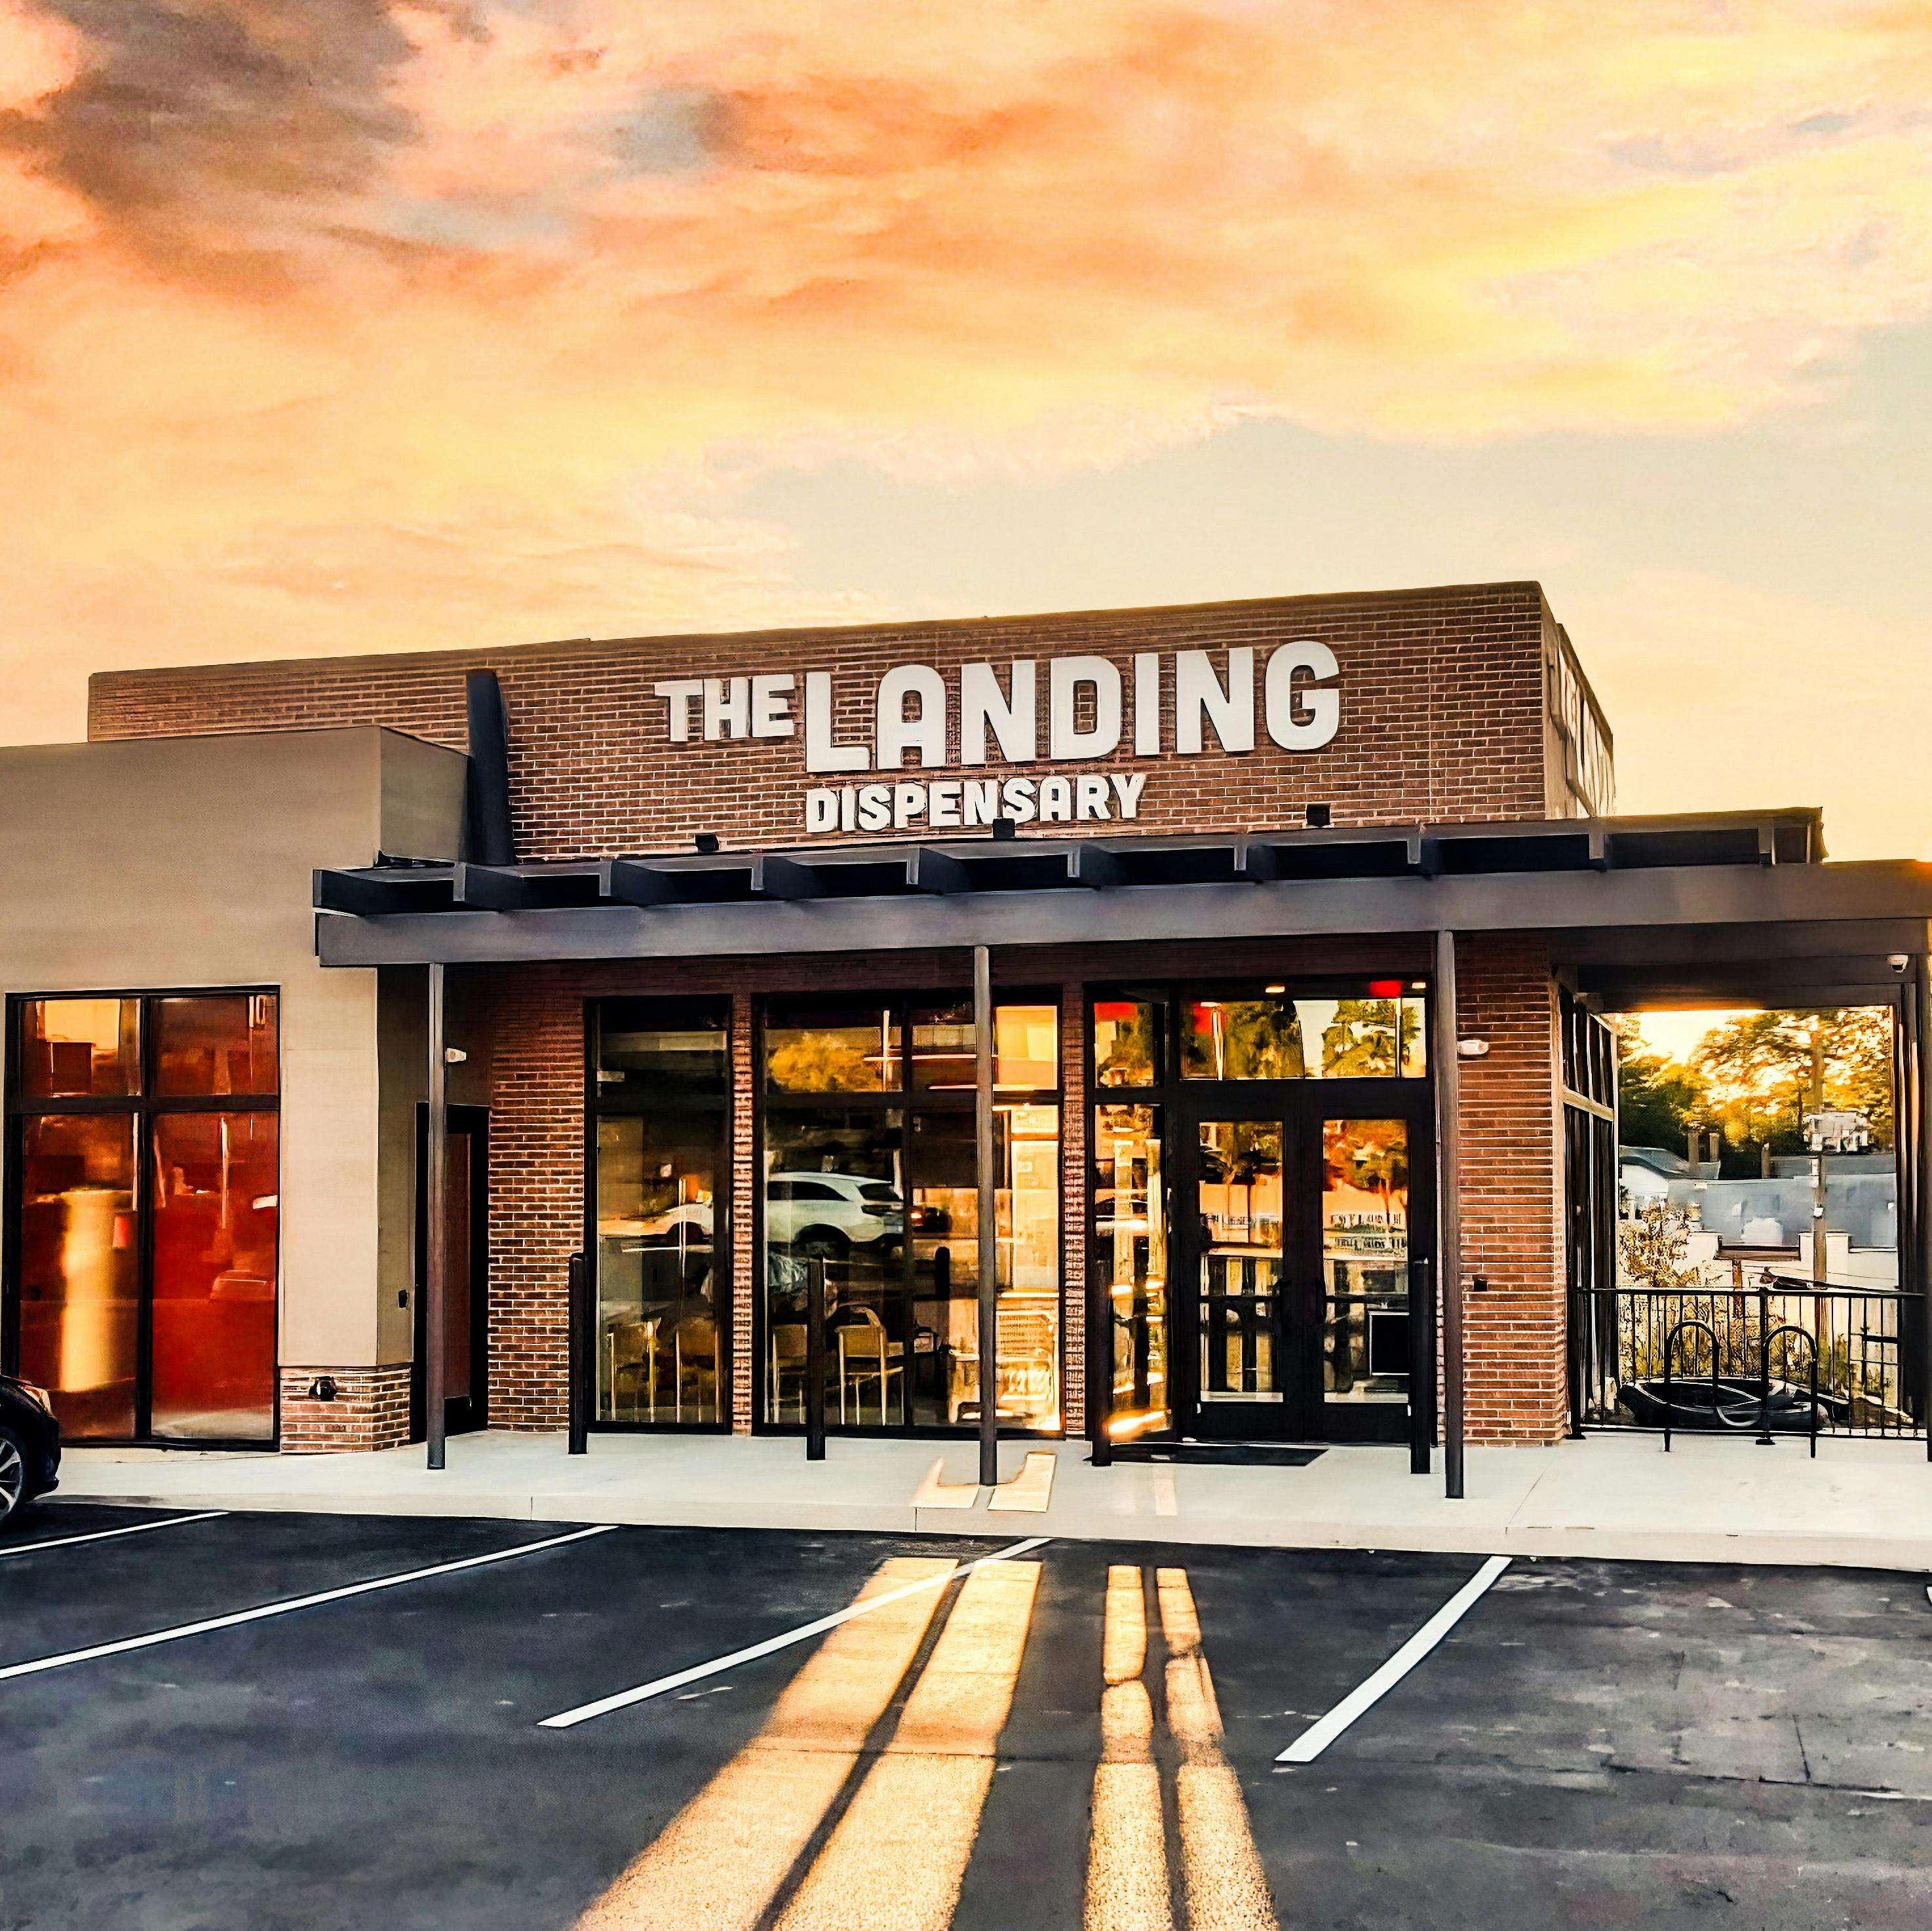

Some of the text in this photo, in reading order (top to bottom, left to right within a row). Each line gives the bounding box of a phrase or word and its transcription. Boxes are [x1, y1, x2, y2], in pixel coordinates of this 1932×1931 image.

[654, 641, 1340, 772] THE LANDING
[806, 773, 1146, 833] DISPENSARY
